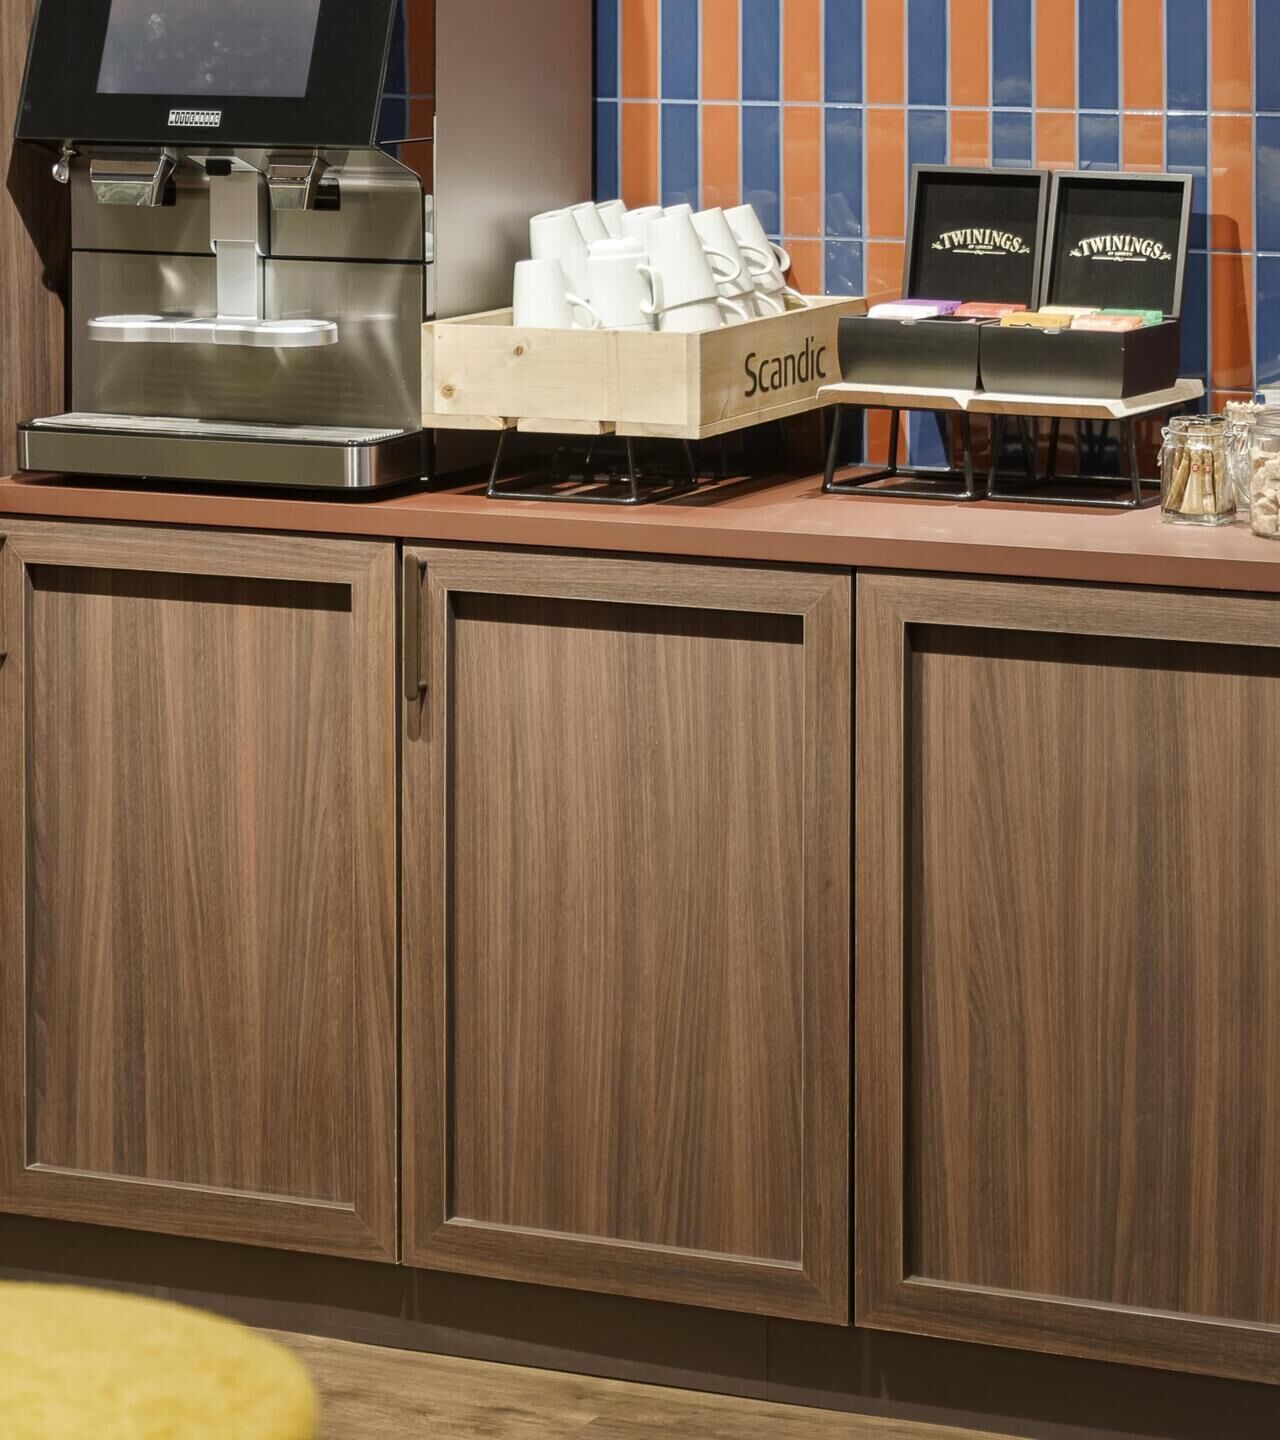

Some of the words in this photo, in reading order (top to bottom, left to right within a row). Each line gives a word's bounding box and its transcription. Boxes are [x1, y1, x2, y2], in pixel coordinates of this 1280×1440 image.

[940, 229, 1022, 252] TWININGS
[1078, 235, 1163, 259] TWININGS
[744, 329, 827, 398] Scandic
